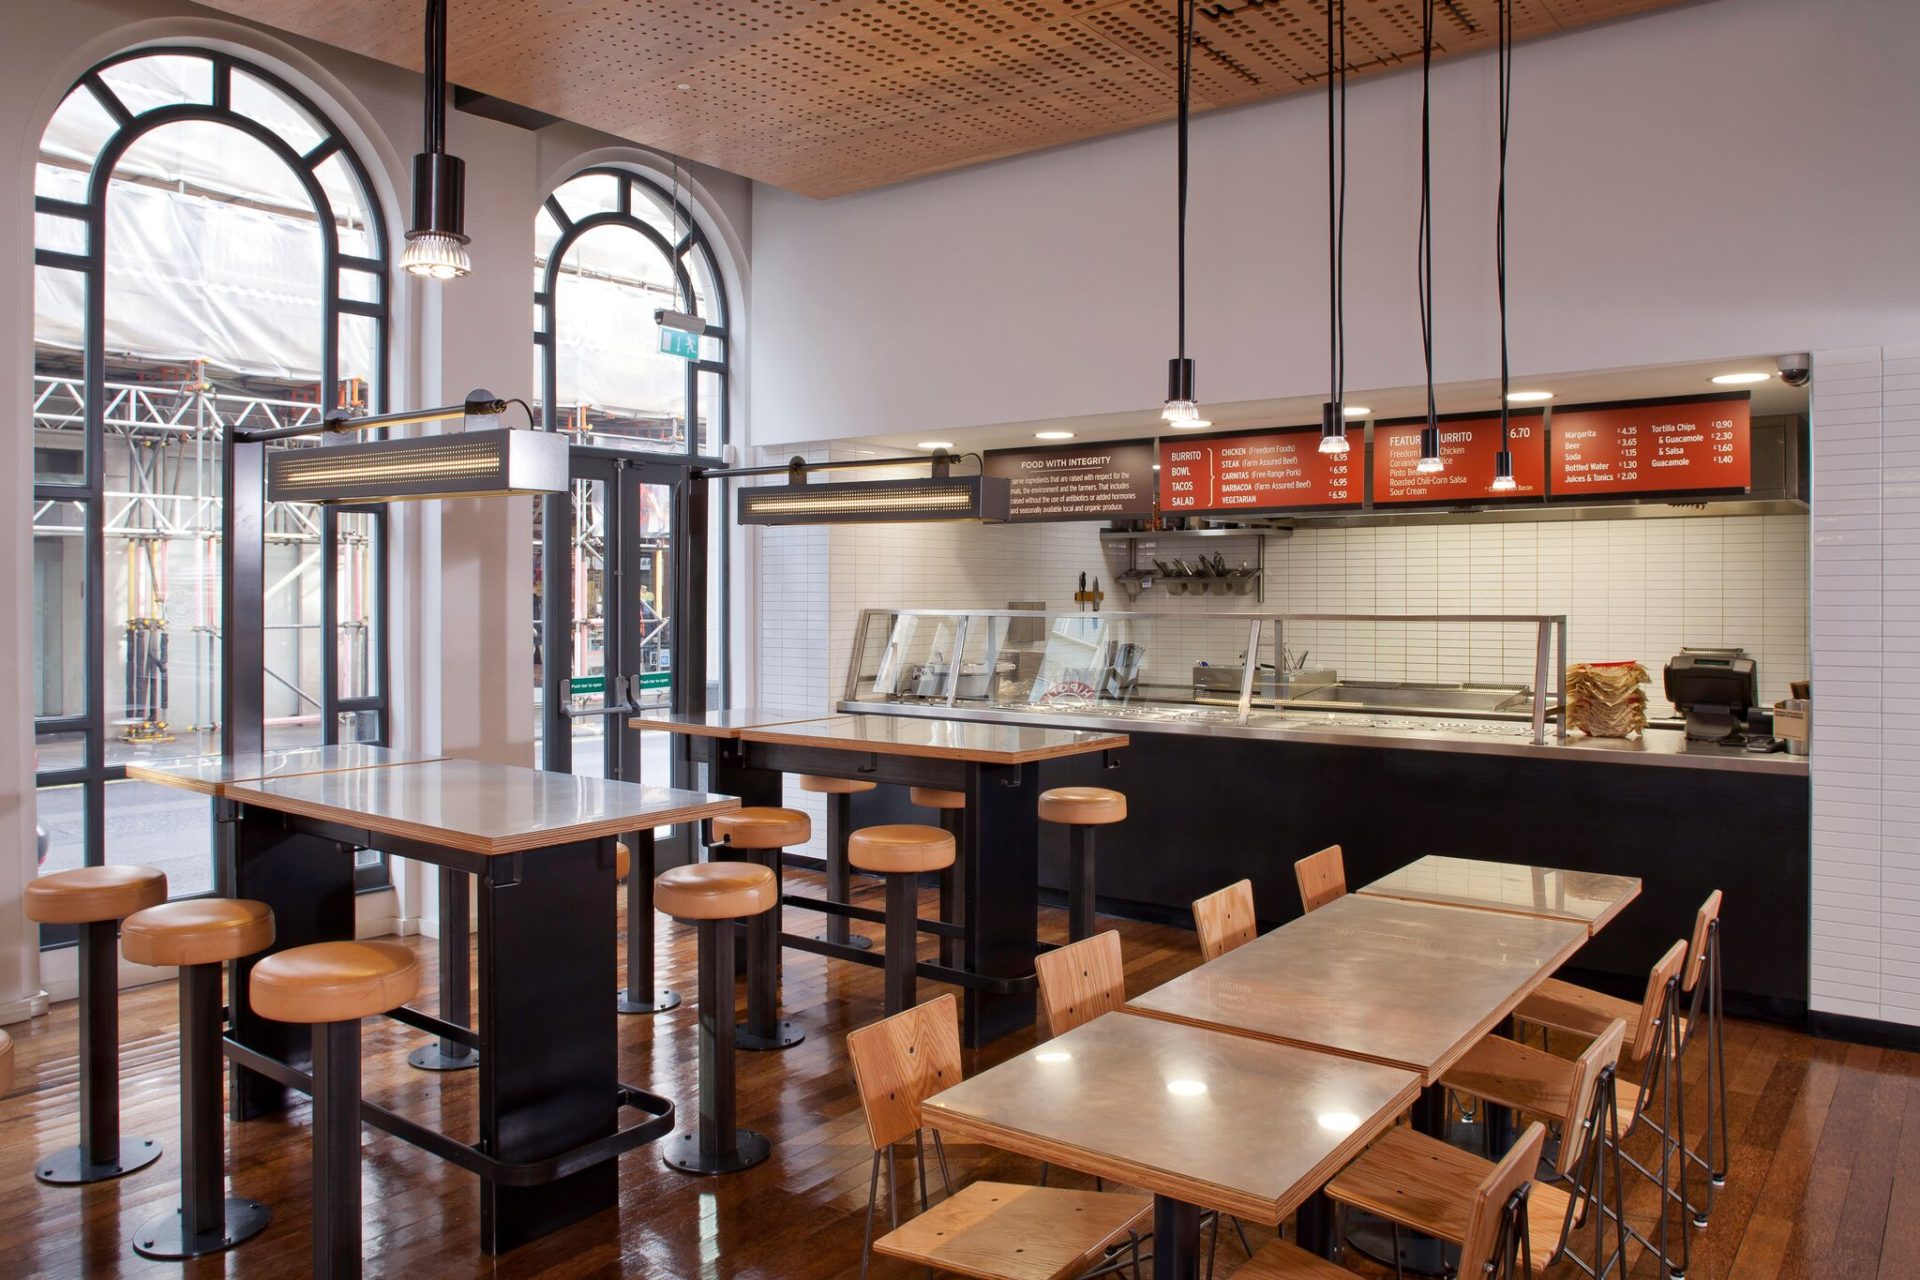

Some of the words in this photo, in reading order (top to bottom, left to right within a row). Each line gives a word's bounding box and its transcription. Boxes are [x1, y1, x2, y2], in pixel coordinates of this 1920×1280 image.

[1652, 424, 1675, 433] Tortilla
[1677, 423, 1696, 432] Chips
[1390, 435, 1421, 446] FEATUR
[1440, 432, 1472, 443] URRITO
[1565, 430, 1596, 439] Margarita
[1659, 436, 1664, 444] &
[1665, 434, 1704, 443] Guacamole
[1221, 448, 1246, 456] CHICKEN
[1249, 446, 1275, 454] (Freedom
[1276, 445, 1295, 453] Foods)
[1565, 442, 1580, 450] Beer
[1665, 447, 1684, 455] Salsa
[1172, 450, 1201, 461] BURRITO
[1390, 449, 1418, 458] Freedom
[1440, 447, 1465, 455] Chicken
[1565, 453, 1581, 461] Soda
[1021, 460, 1044, 469] FOOD
[1046, 459, 1067, 467] WITH
[1068, 456, 1111, 466] INTEGRITY
[1221, 460, 1240, 468] STEAK
[1242, 459, 1258, 467] (Farm
[1260, 458, 1281, 466] Assured
[1283, 456, 1298, 464] Beef)
[1652, 458, 1690, 467] Guacamole
[1172, 466, 1191, 476] BOWL
[1565, 464, 1588, 472] Bottled
[1095, 473, 1112, 481] respect
[1222, 472, 1249, 480] CARNITAS
[1252, 470, 1266, 479] (Free
[1267, 470, 1285, 478] Range
[1286, 469, 1301, 477] Pork)
[1587, 474, 1592, 482] &
[1417, 476, 1448, 485] Chili-Corn
[1449, 475, 1467, 484] Salsa
[1172, 482, 1193, 491] TACOS
[1222, 483, 1252, 492] BARBACOA
[1254, 482, 1270, 491] (Farm
[1272, 481, 1294, 490] Assured
[1296, 480, 1311, 488] Beef)
[1390, 488, 1404, 496] Sour
[1406, 487, 1427, 495] Cream
[1172, 496, 1194, 506] SALAD
[1222, 496, 1256, 504] VEGETARIAN
[1085, 504, 1101, 512] organic
